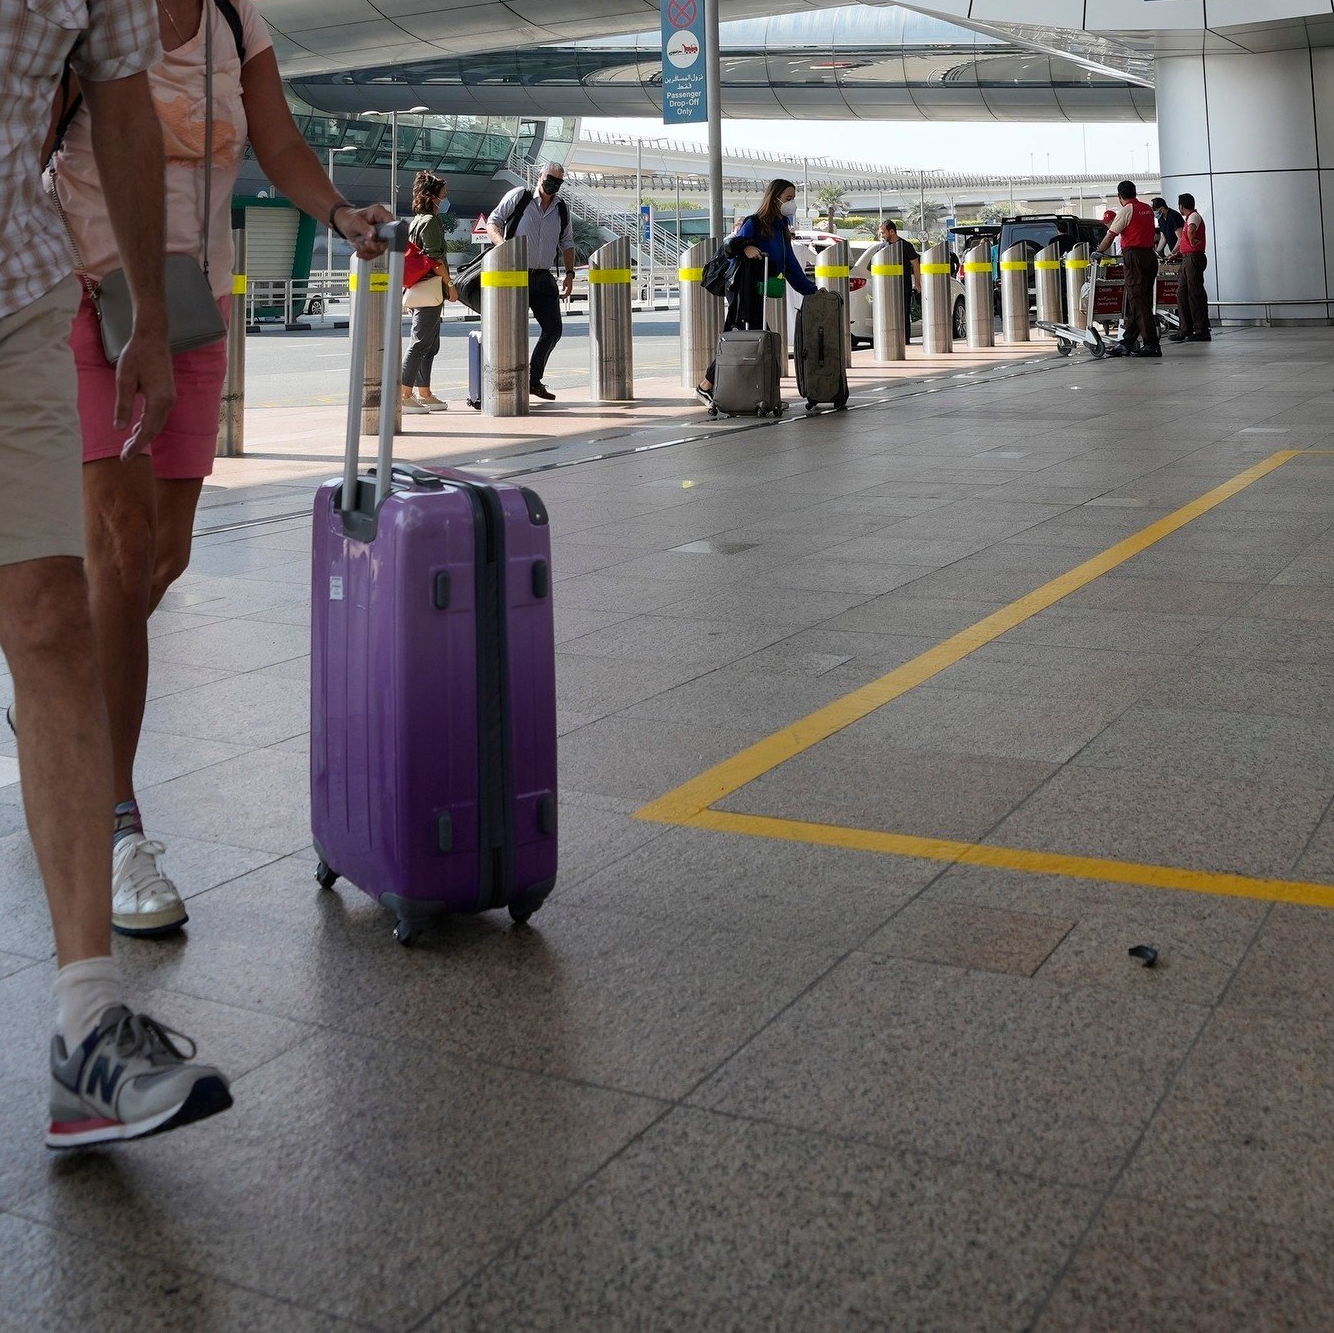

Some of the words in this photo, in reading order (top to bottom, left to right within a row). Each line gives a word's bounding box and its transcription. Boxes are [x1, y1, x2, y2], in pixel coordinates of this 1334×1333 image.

[667, 91, 701, 99] Passenger
[670, 99, 699, 107] Drop-Off
[677, 108, 692, 116] Only
